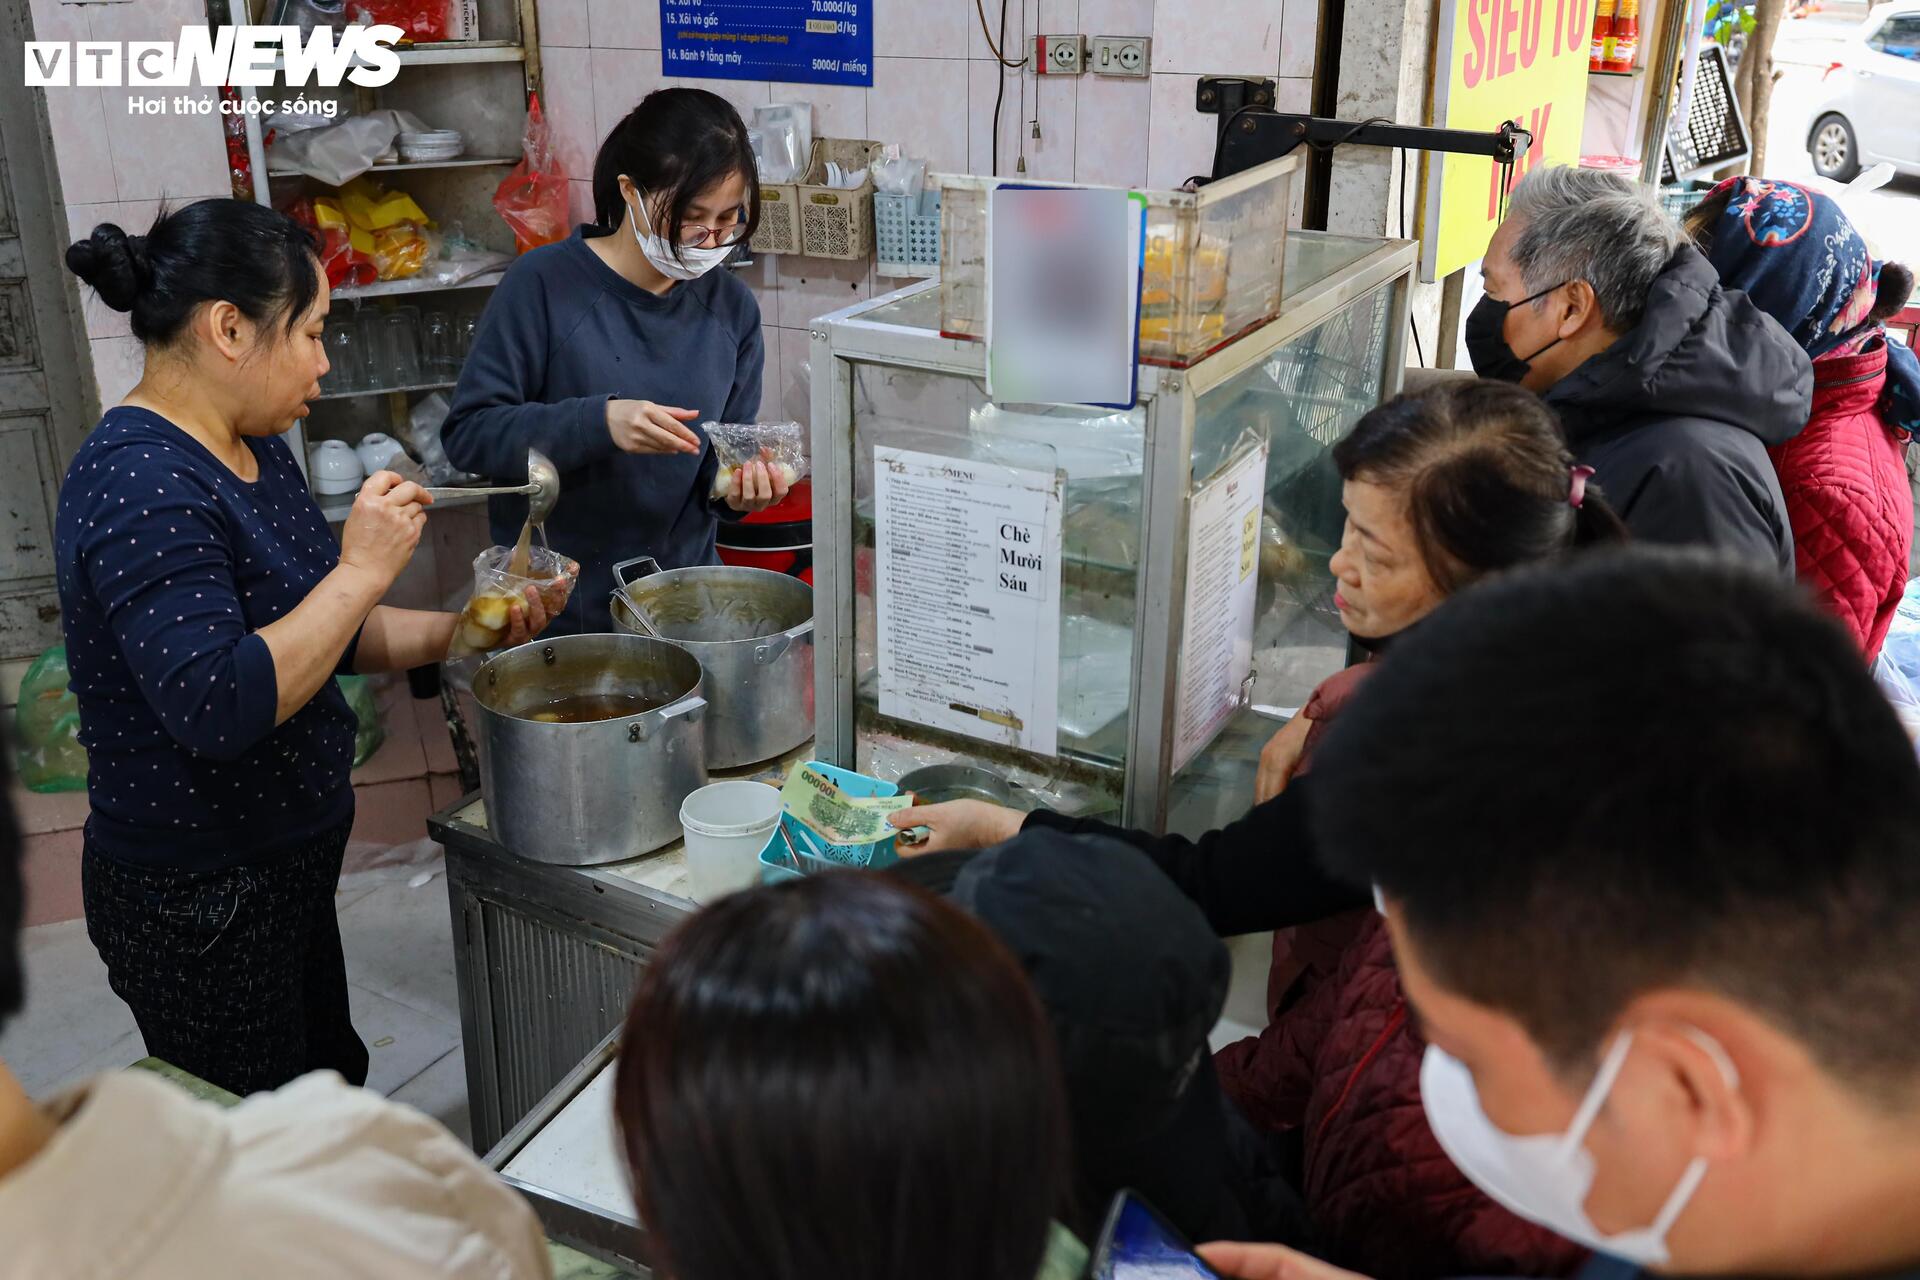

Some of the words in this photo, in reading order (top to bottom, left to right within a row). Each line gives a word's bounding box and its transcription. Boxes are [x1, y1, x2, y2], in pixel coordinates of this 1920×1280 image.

[1000, 524, 1031, 544] Chè
[1000, 547, 1042, 571] Mười
[1000, 572, 1028, 592] Sáu
